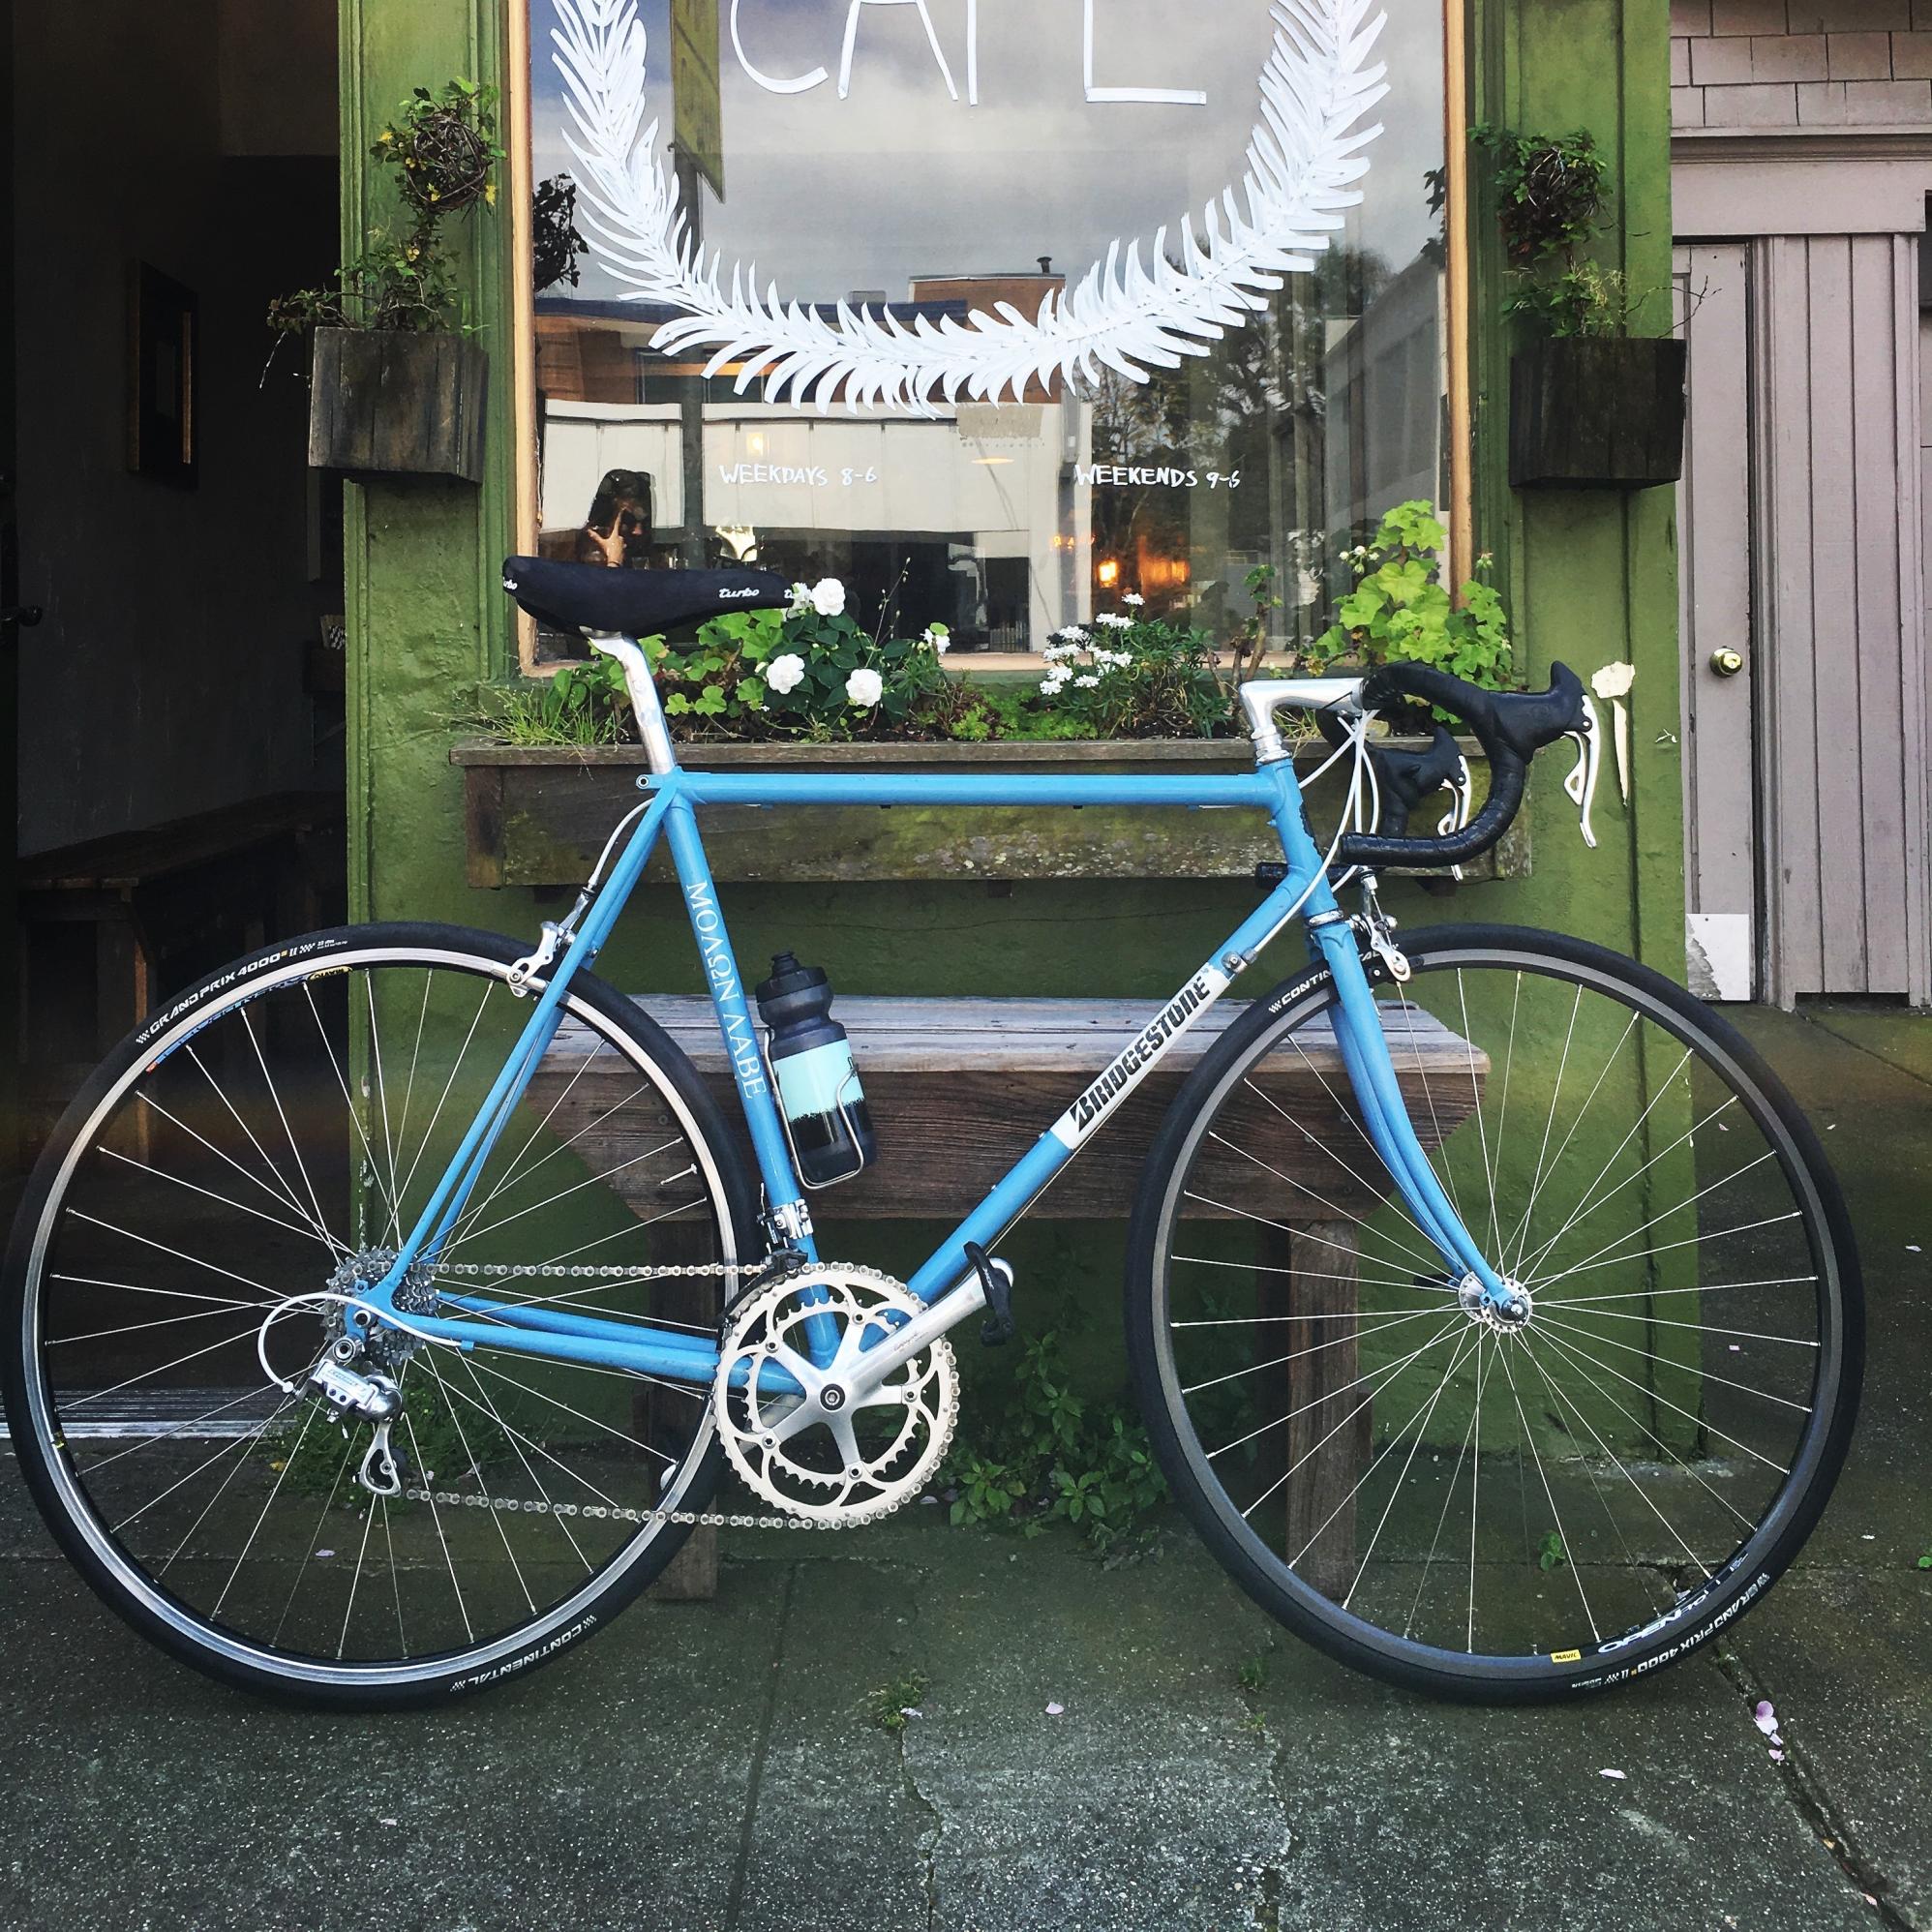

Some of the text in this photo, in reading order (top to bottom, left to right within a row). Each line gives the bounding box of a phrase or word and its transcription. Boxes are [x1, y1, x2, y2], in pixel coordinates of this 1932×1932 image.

[718, 464, 877, 486] WEEKDAYS 8-6
[1074, 464, 1241, 489] WEEKENDS 9-6
[718, 588, 760, 598] turbo
[149, 992, 198, 1035] GRAND
[199, 971, 236, 998] PRIX
[237, 953, 281, 976] 4000
[1069, 976, 1210, 1132] BRIDGESTONE
[1713, 1582, 1759, 1629] GRAND
[1679, 1622, 1714, 1650] PRIX
[468, 1623, 583, 1685] CONTINENTAL
[1554, 1651, 1579, 1660] MAVIC
[1637, 1647, 1679, 1673] 4000
